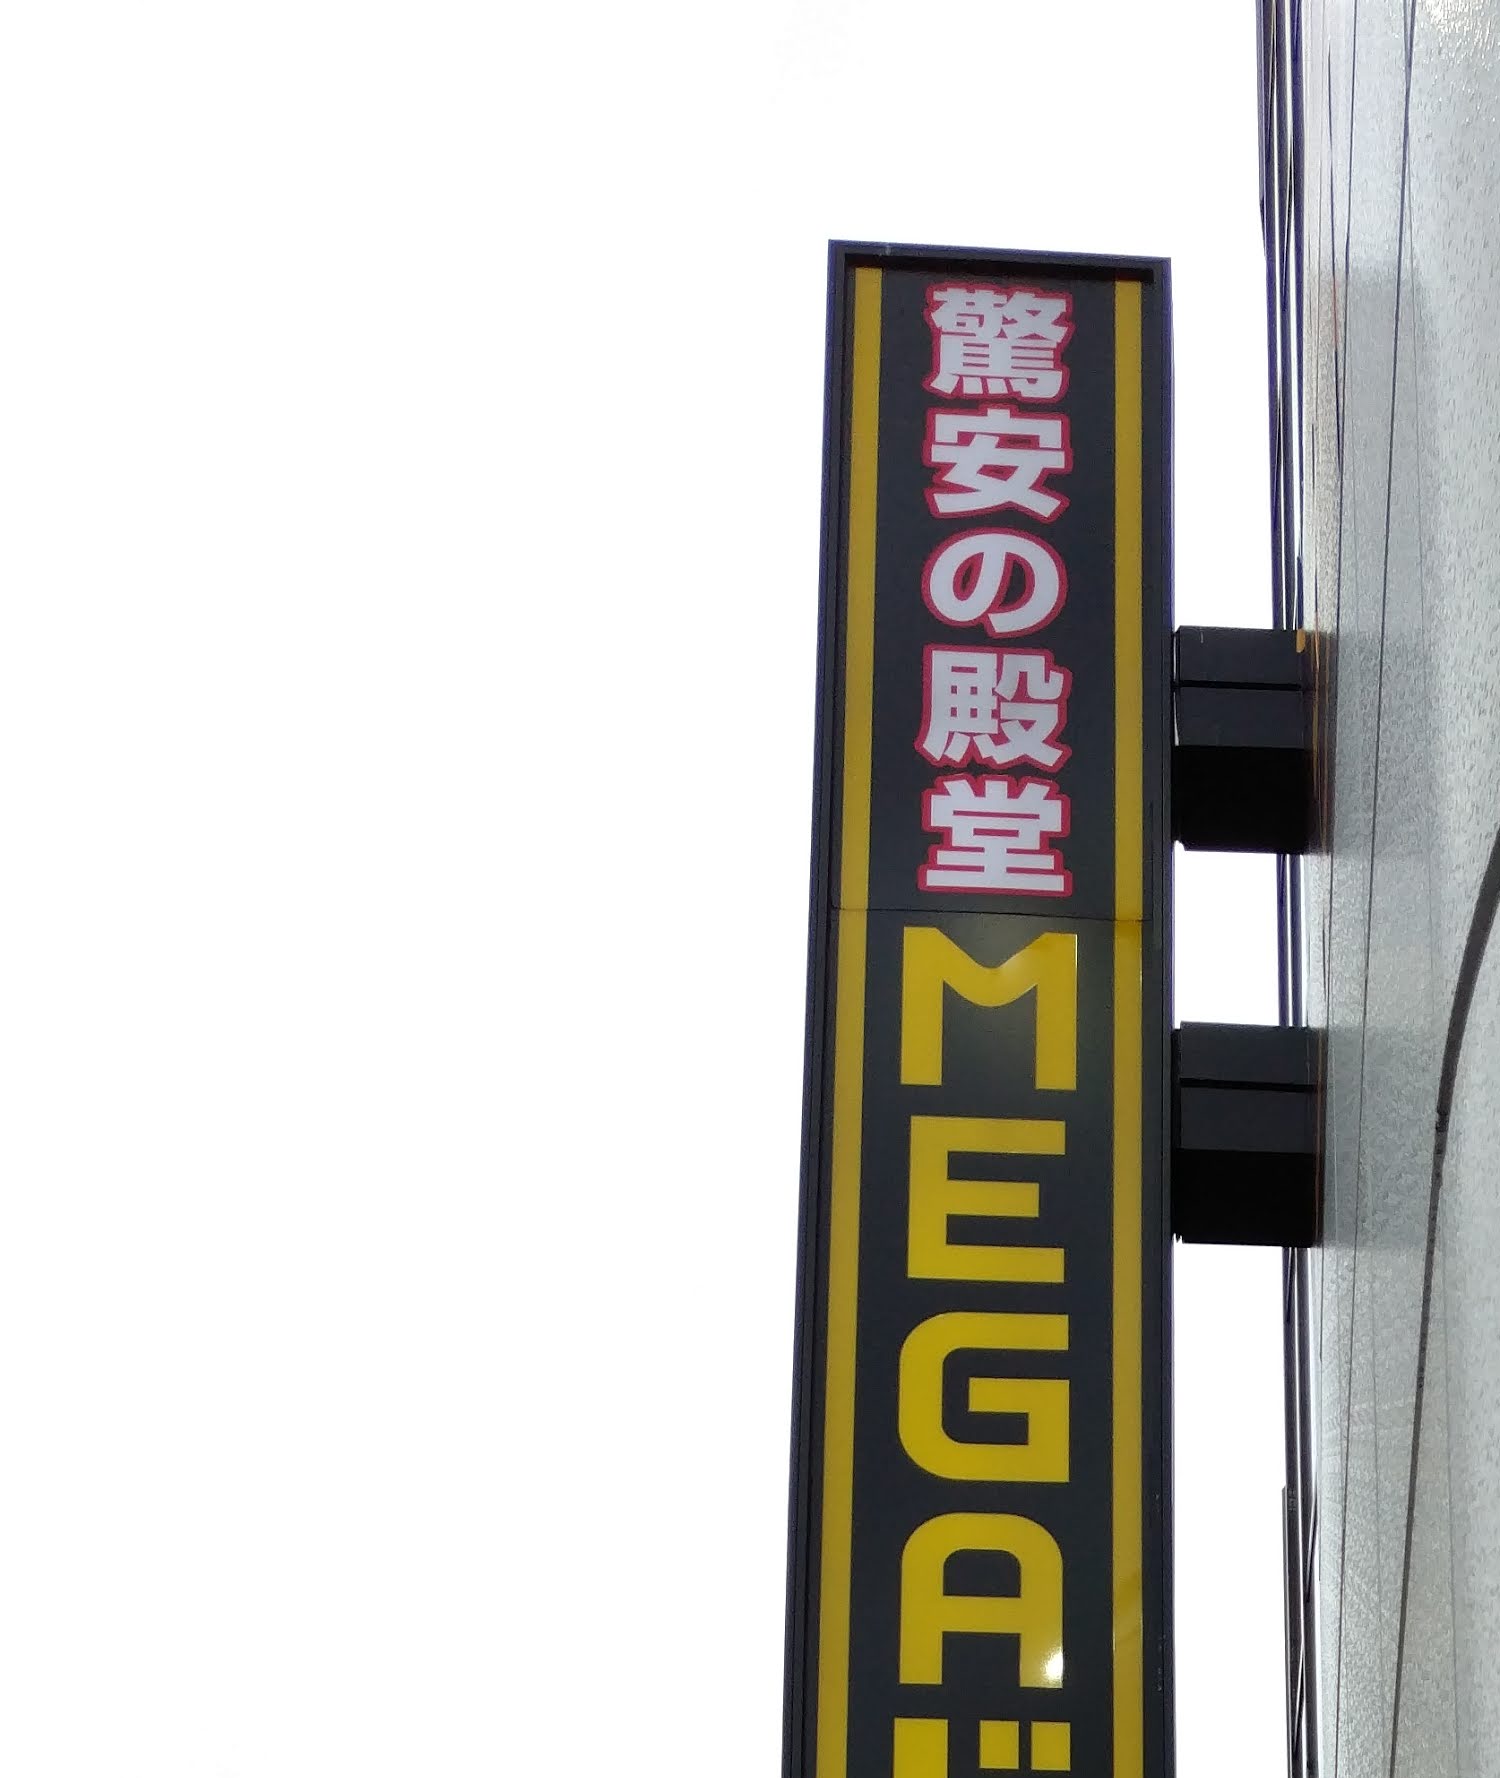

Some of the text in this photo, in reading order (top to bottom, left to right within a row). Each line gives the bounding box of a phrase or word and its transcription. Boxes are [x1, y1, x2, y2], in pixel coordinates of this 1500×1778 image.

[920, 283, 1071, 896] 驚安の殿堂
